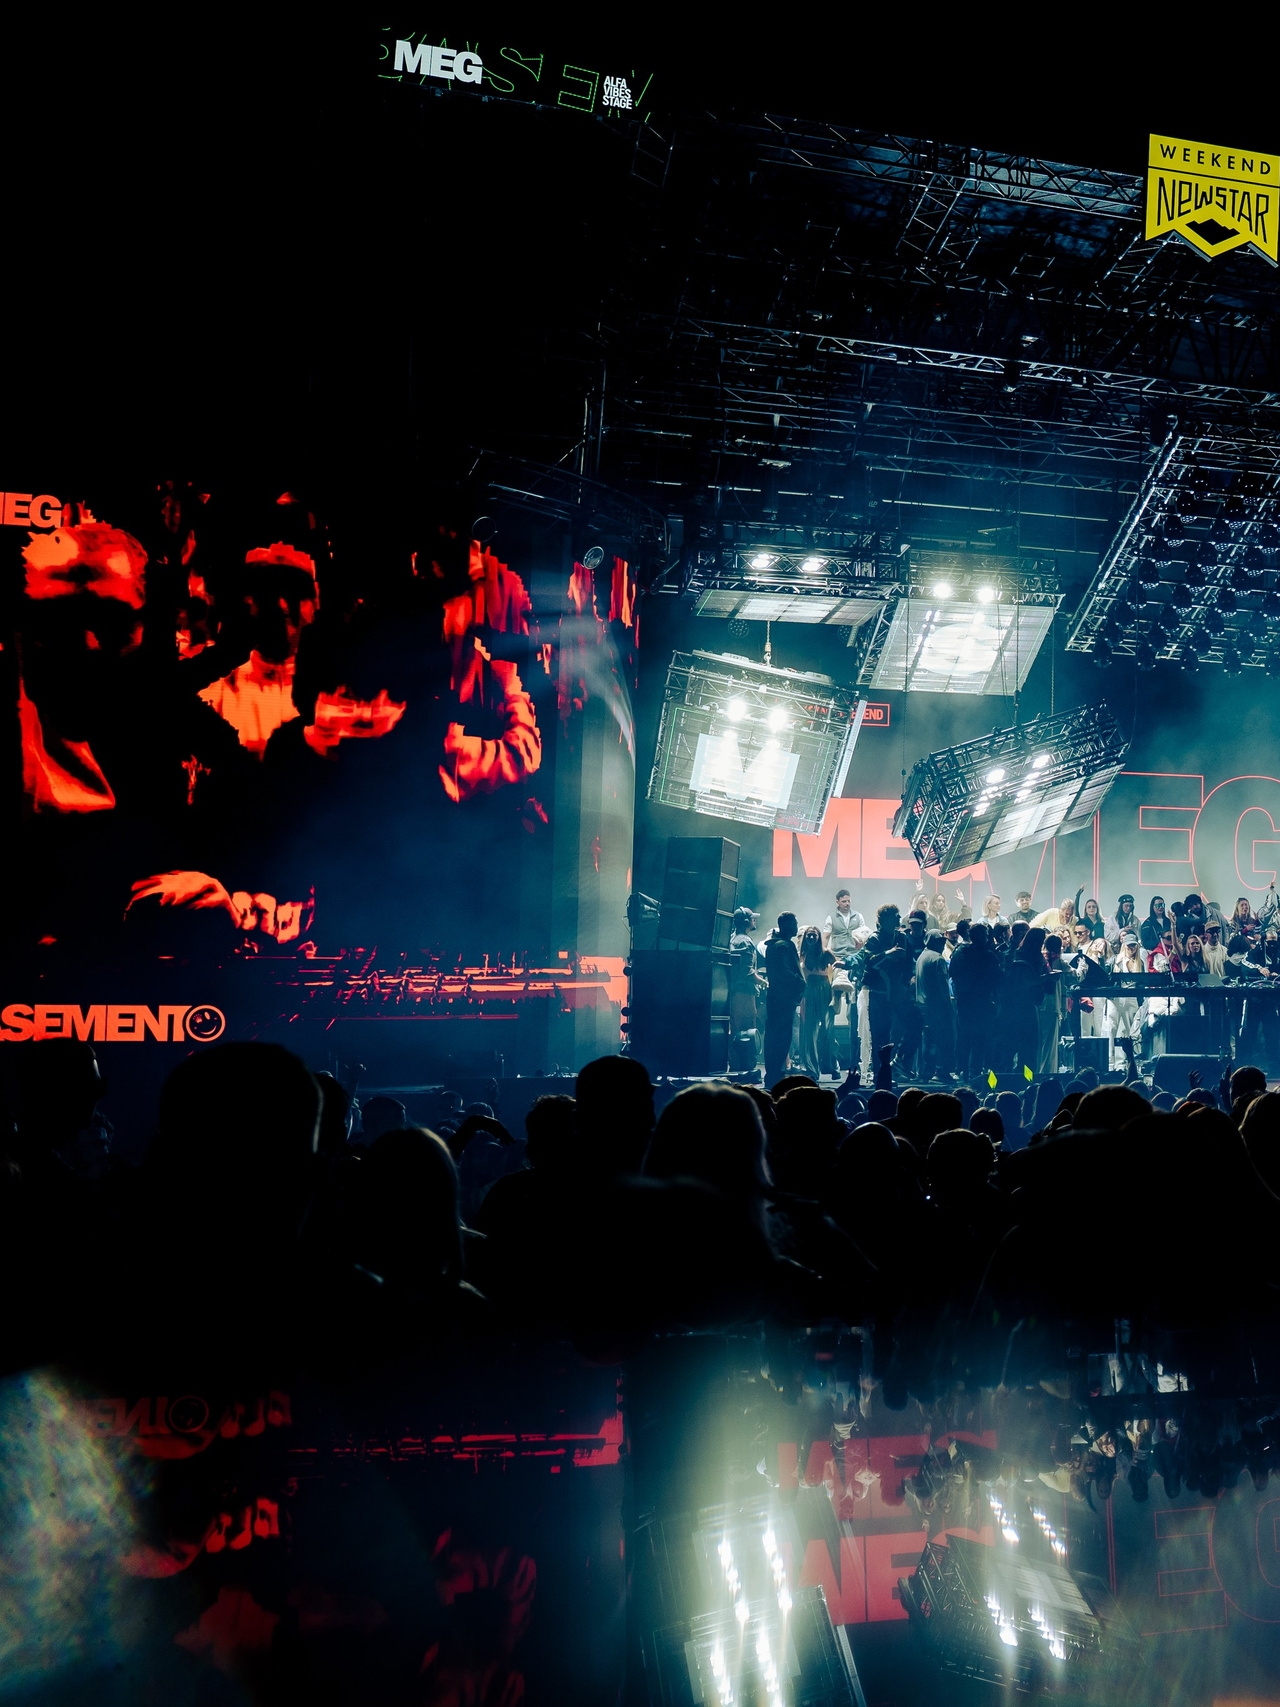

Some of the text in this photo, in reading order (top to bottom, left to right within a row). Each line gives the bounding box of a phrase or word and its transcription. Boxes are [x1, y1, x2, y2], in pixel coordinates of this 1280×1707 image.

[393, 40, 483, 84] MEG
[603, 85, 631, 99] VIBES
[604, 75, 627, 89] ALFA
[602, 95, 633, 110] STAGE
[1159, 143, 1271, 175] WEEKEND
[0, 491, 63, 529] EG
[772, 796, 986, 882] ME
[0, 1003, 226, 1042] SEMENTO
